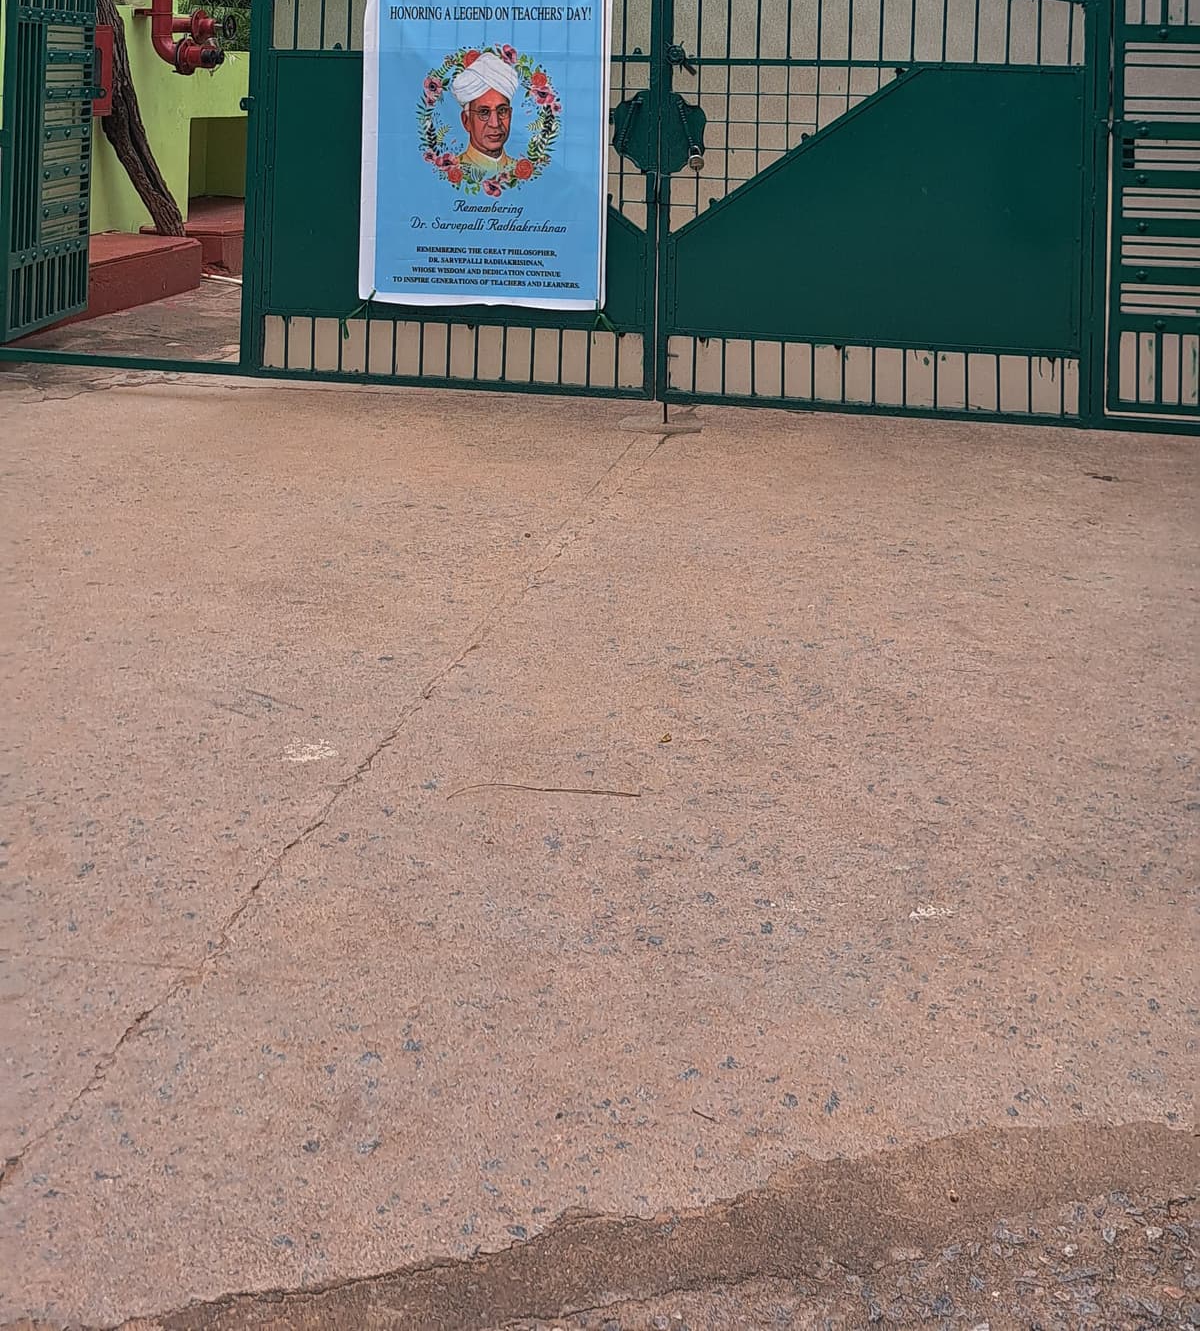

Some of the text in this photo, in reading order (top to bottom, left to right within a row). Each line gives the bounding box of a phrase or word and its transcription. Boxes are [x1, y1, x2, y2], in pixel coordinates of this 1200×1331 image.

[390, 6, 592, 21] HONORING A LEGEND ON TEACHERS' DAY!
[453, 199, 524, 218] Remembering
[410, 216, 567, 234] Dr. Sarvepalli Radhakrishnan
[416, 246, 557, 258] REMEMBERING THE GREAT PHILOSOPHER,
[428, 256, 440, 264] DR.
[441, 257, 482, 265] SARVEPALLI
[412, 266, 437, 274] WHOSE
[438, 267, 466, 275] WISDOM
[482, 269, 525, 277] DEDICATION
[526, 270, 561, 278] CONTINUE
[404, 276, 430, 284] INSPIRE
[431, 277, 479, 286] GENERATIONS
[491, 279, 526, 287] TEACHERS
